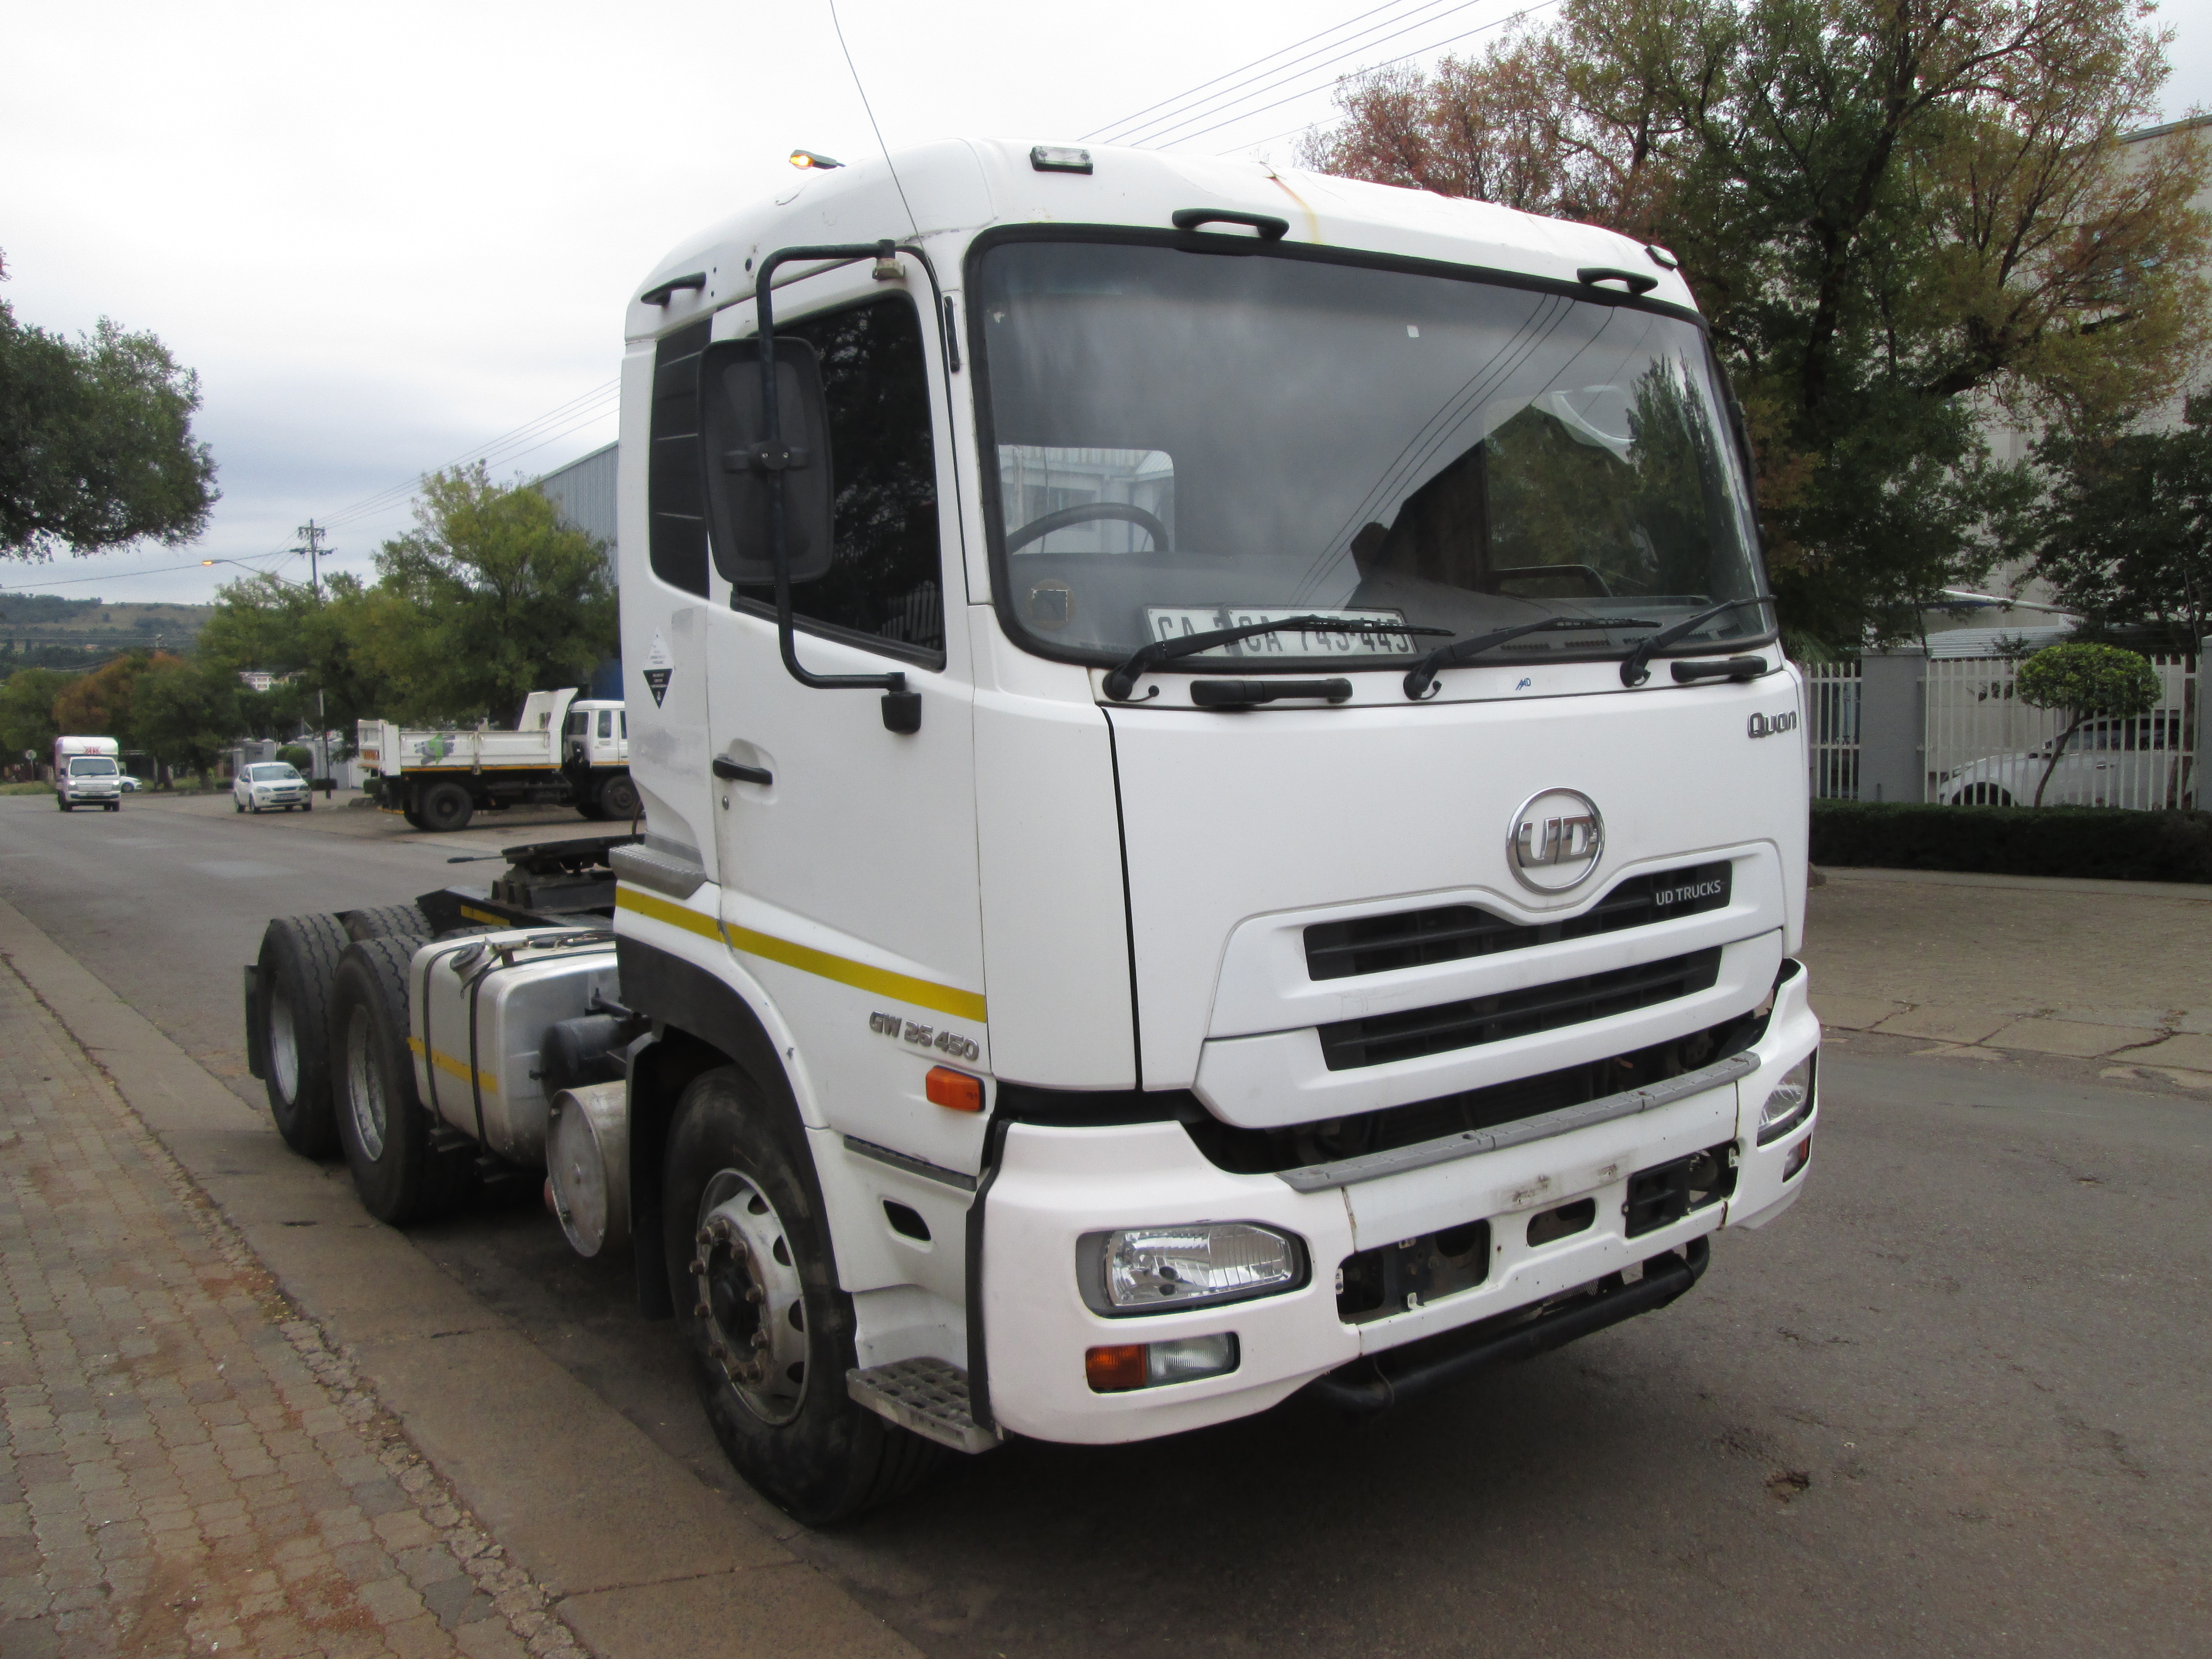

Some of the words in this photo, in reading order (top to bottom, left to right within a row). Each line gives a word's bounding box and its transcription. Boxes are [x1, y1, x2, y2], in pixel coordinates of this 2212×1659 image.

[1238, 615, 1283, 652] CA
[1747, 710, 1797, 738] Quon
[1517, 814, 1598, 867] UD
[1656, 890, 1674, 906] UD
[1675, 879, 1721, 902] TRUCKS
[869, 1010, 902, 1038] GW
[904, 1020, 933, 1047] 26
[934, 1030, 980, 1061] 450
